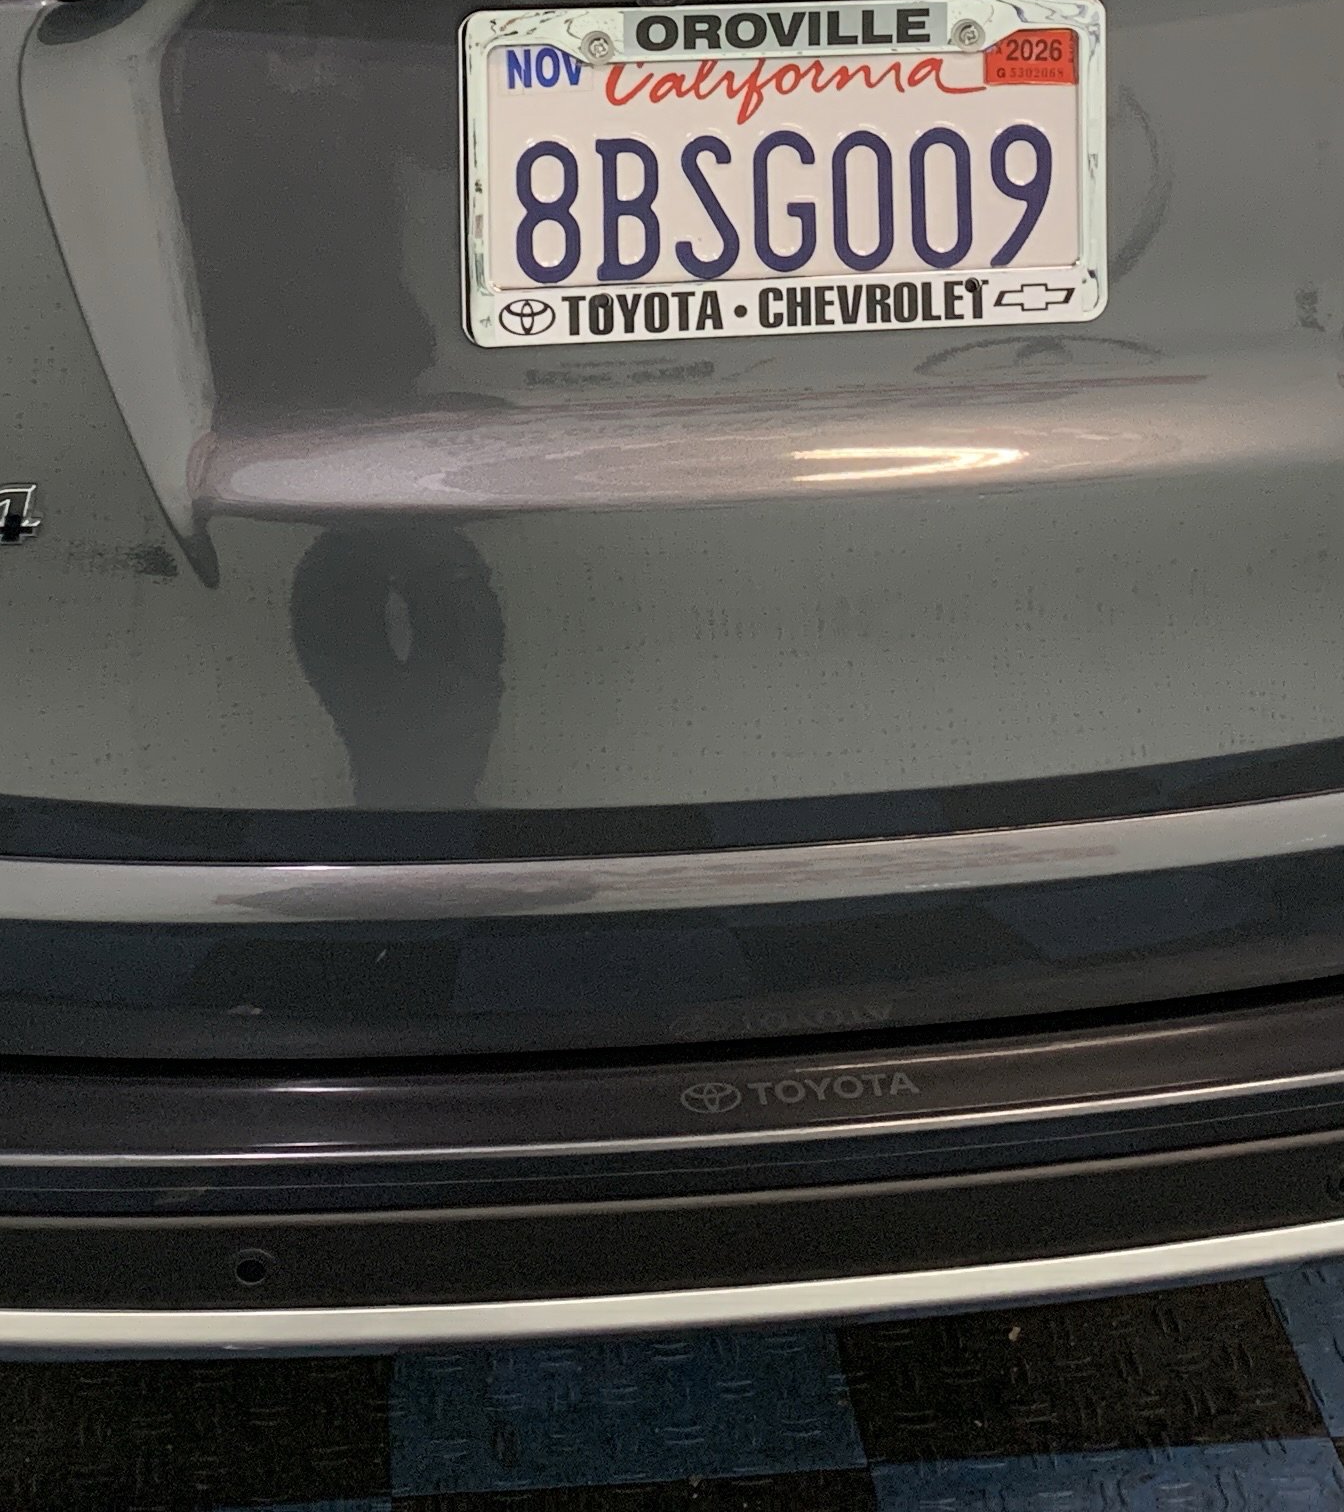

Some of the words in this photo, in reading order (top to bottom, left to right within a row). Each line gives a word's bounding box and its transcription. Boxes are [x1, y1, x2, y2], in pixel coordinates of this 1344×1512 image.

[635, 8, 931, 52] OROVILLE
[1005, 38, 1063, 62] 2026
[507, 47, 582, 90] NOV
[605, 58, 987, 125] California
[515, 124, 1053, 284] 8BSG009
[561, 290, 724, 337] TOYOTA
[758, 279, 990, 329] CHEVROLET
[746, 1072, 921, 1106] TOYOTA
